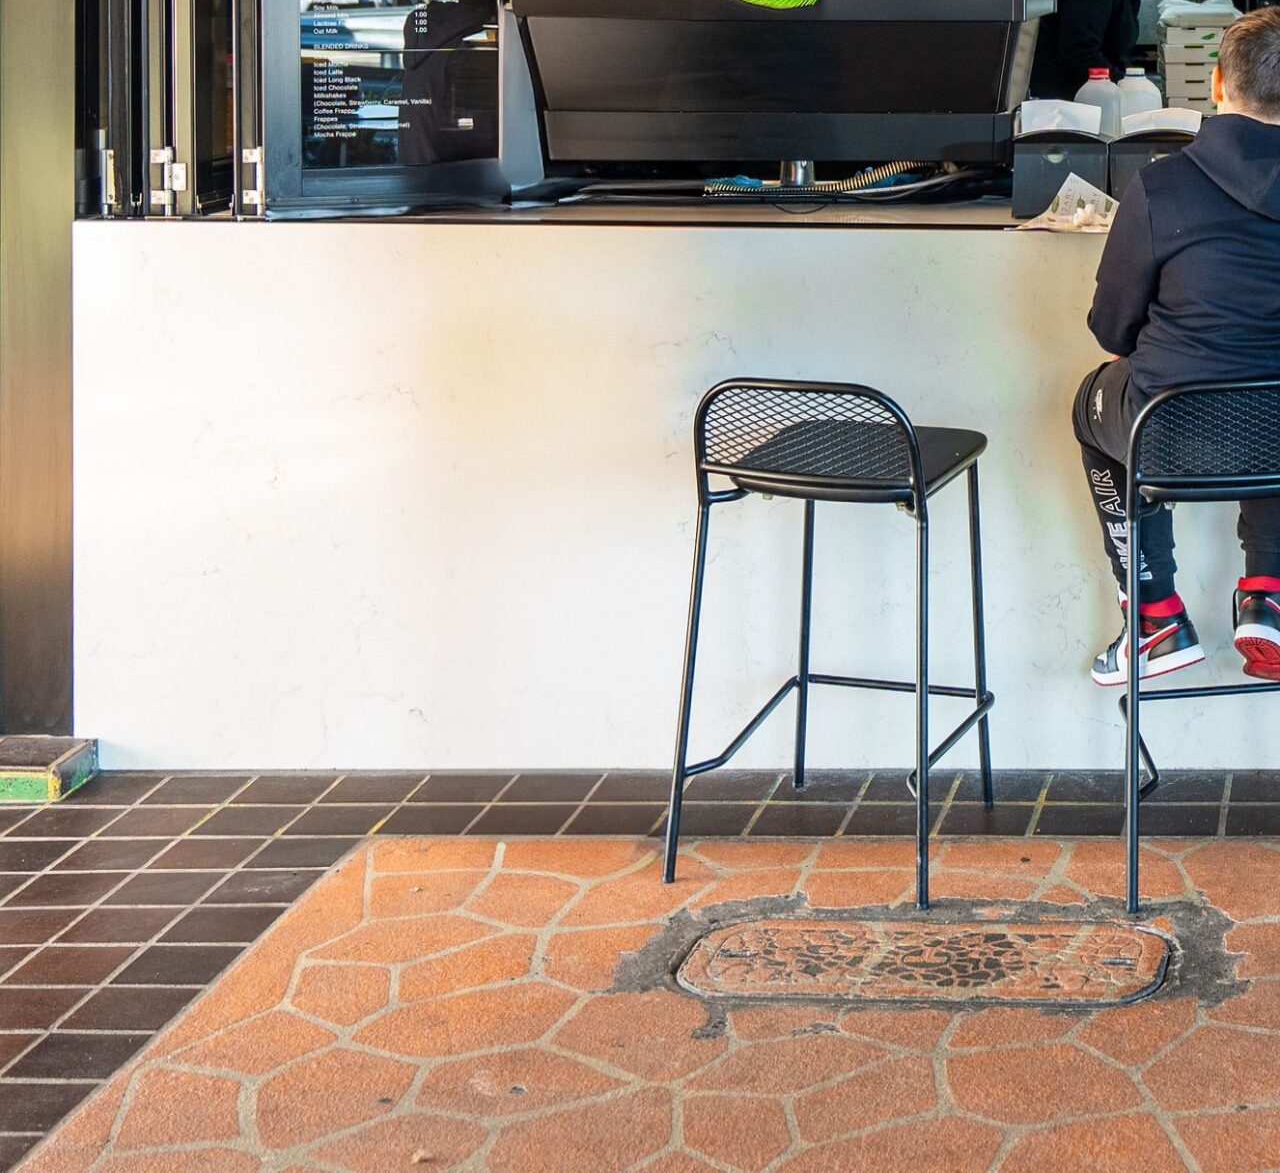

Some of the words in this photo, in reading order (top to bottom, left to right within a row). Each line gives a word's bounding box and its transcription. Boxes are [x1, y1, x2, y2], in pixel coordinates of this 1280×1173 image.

[328, 76, 343, 84] Long
[383, 98, 409, 106] Caramel,
[1090, 468, 1128, 517] AIR
